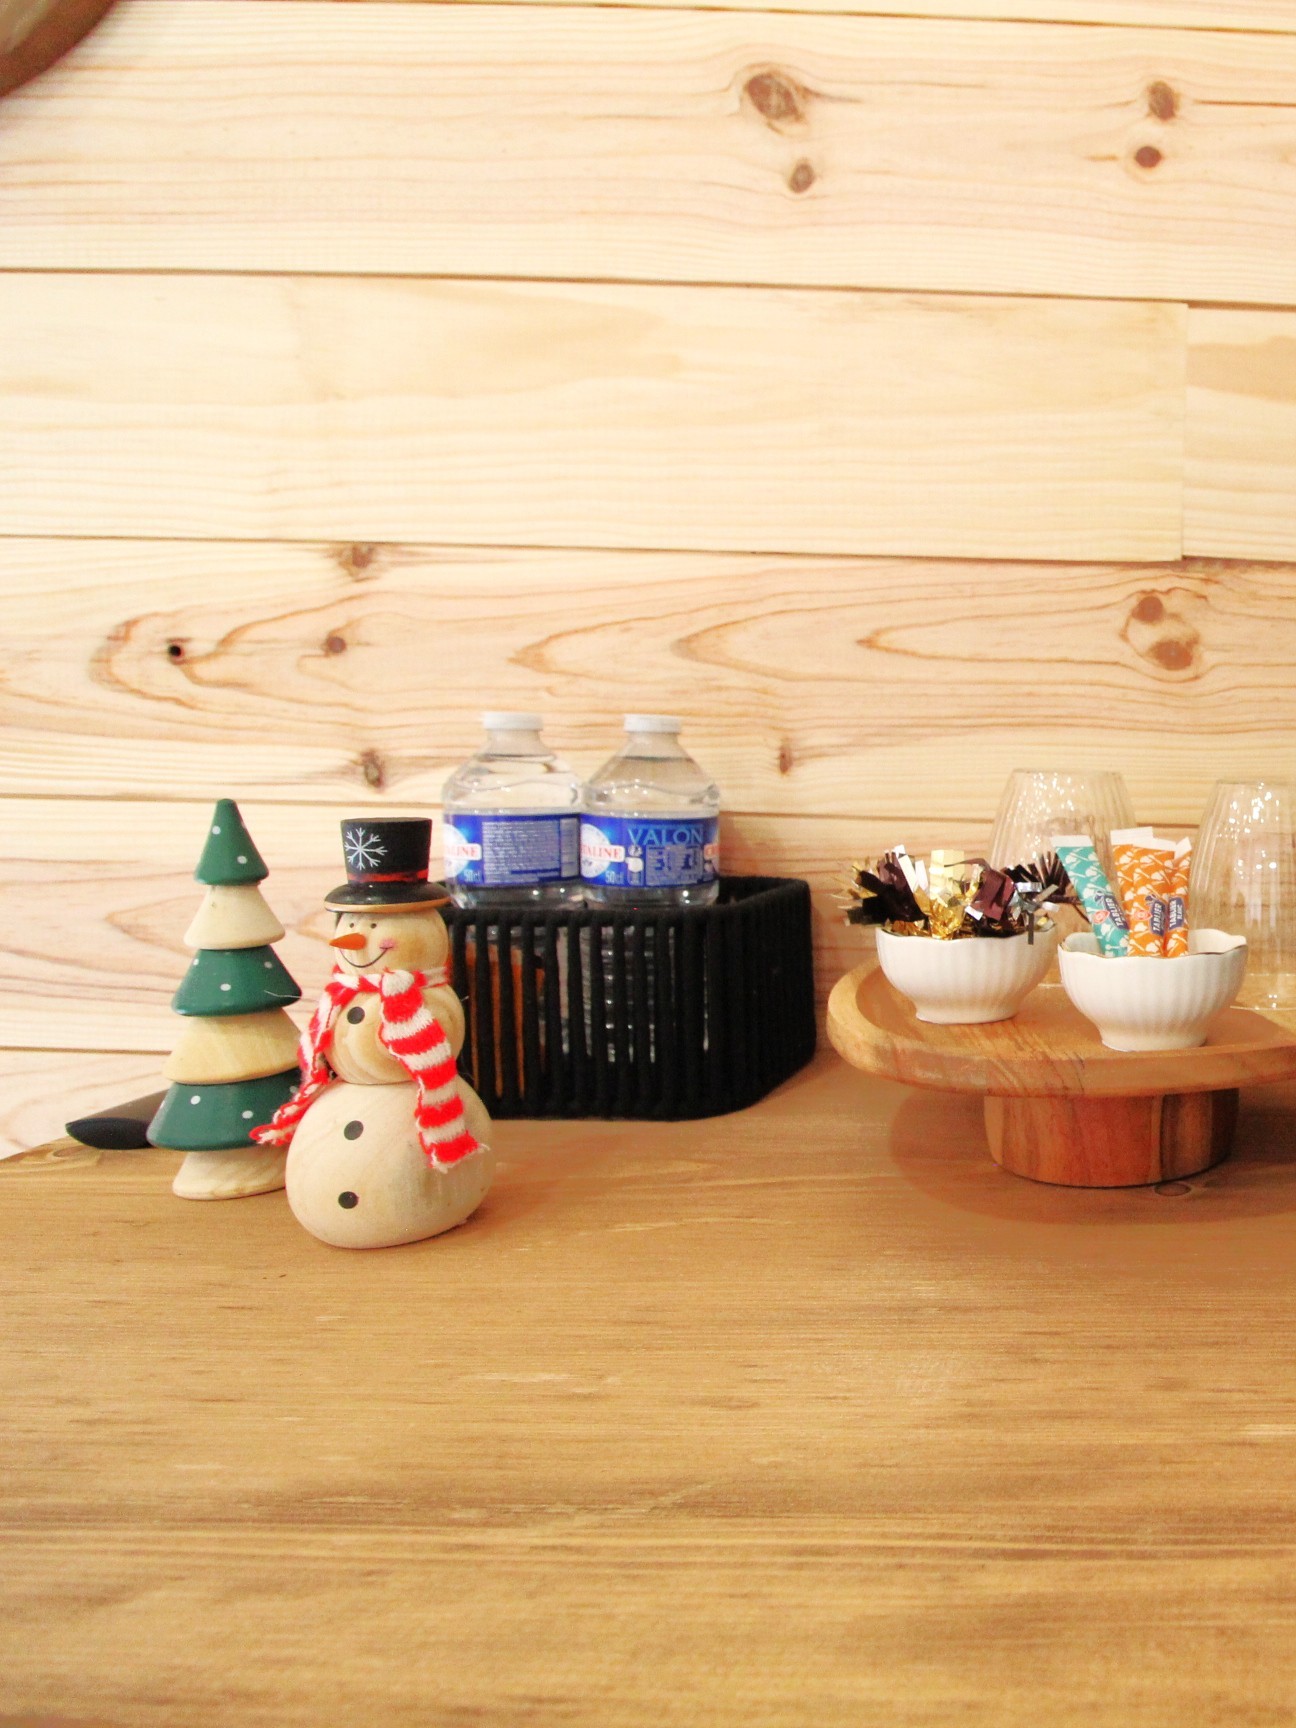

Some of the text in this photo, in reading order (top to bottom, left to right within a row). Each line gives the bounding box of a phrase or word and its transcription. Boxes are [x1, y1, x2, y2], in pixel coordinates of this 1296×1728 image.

[627, 827, 703, 847] VALON
[1105, 897, 1124, 927] TABLIER
[1152, 903, 1163, 932] TABLIER
[1168, 900, 1177, 928] TABLIER
